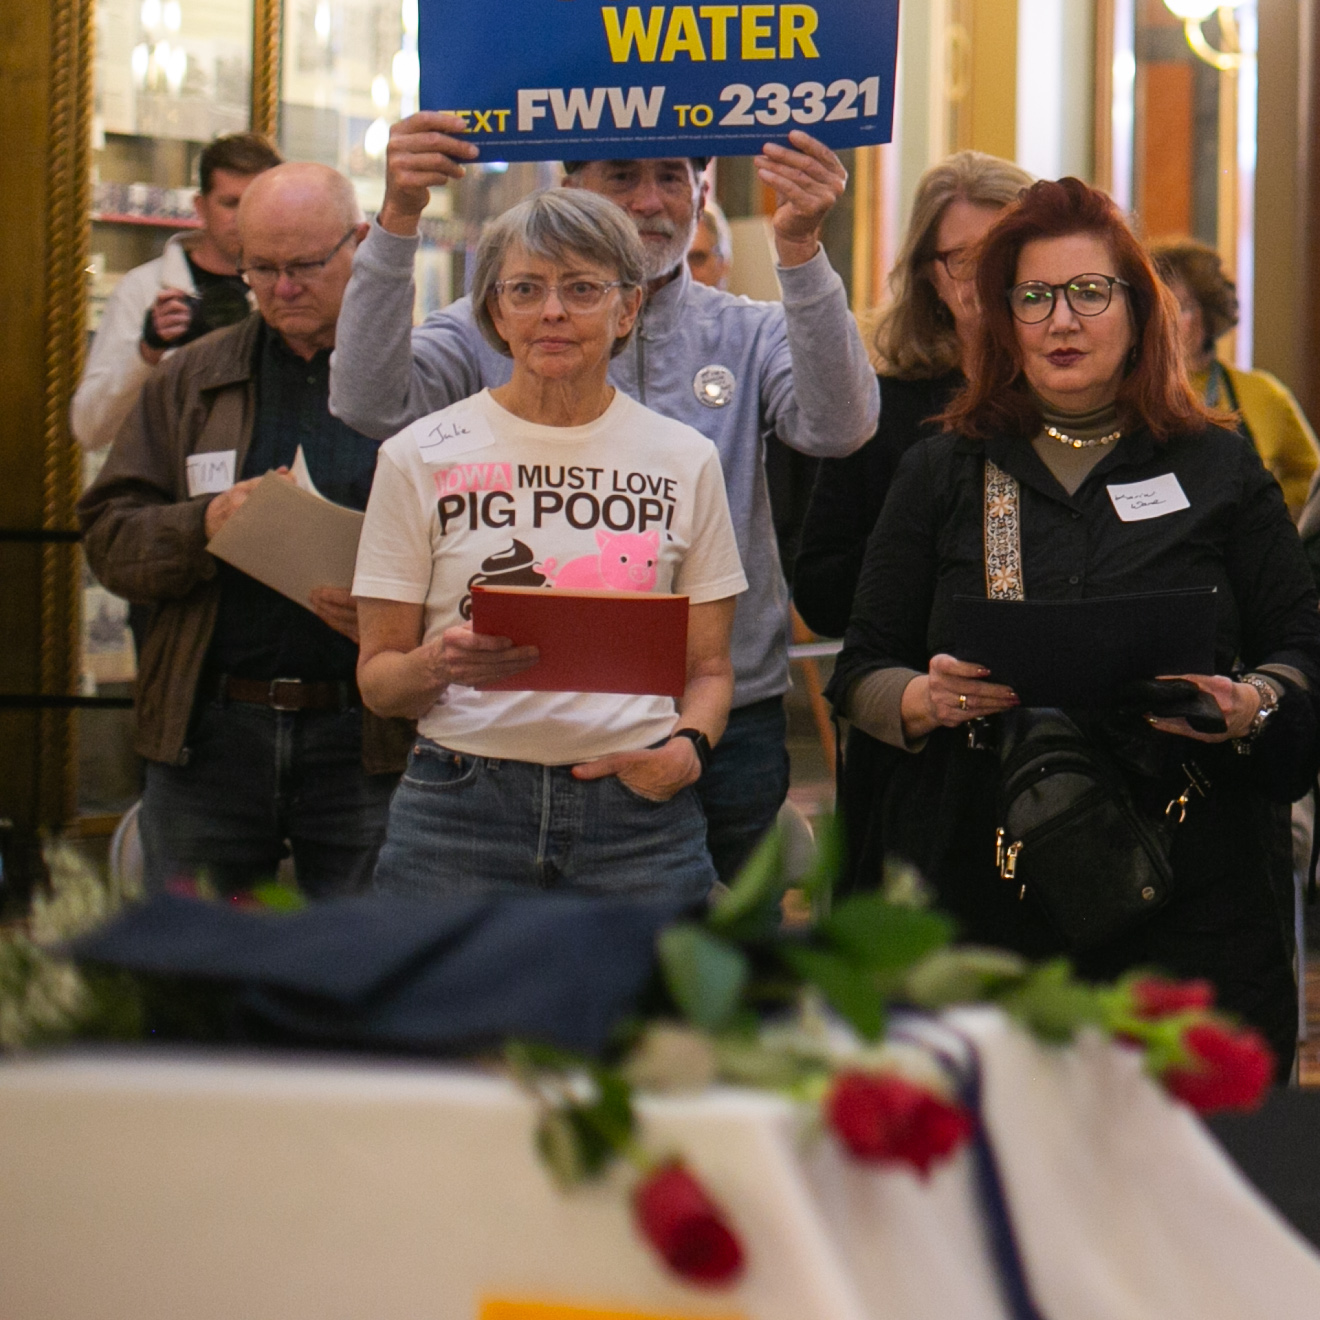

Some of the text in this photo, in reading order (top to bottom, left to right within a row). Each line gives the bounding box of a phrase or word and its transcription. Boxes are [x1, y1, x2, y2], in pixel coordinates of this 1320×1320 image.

[601, 4, 820, 63] WATER
[516, 85, 666, 132] FWW
[673, 104, 714, 127] TO
[718, 76, 881, 127] 23321
[436, 464, 678, 503] IOWA MUST LOVE
[437, 491, 675, 542] PIG POOP!
